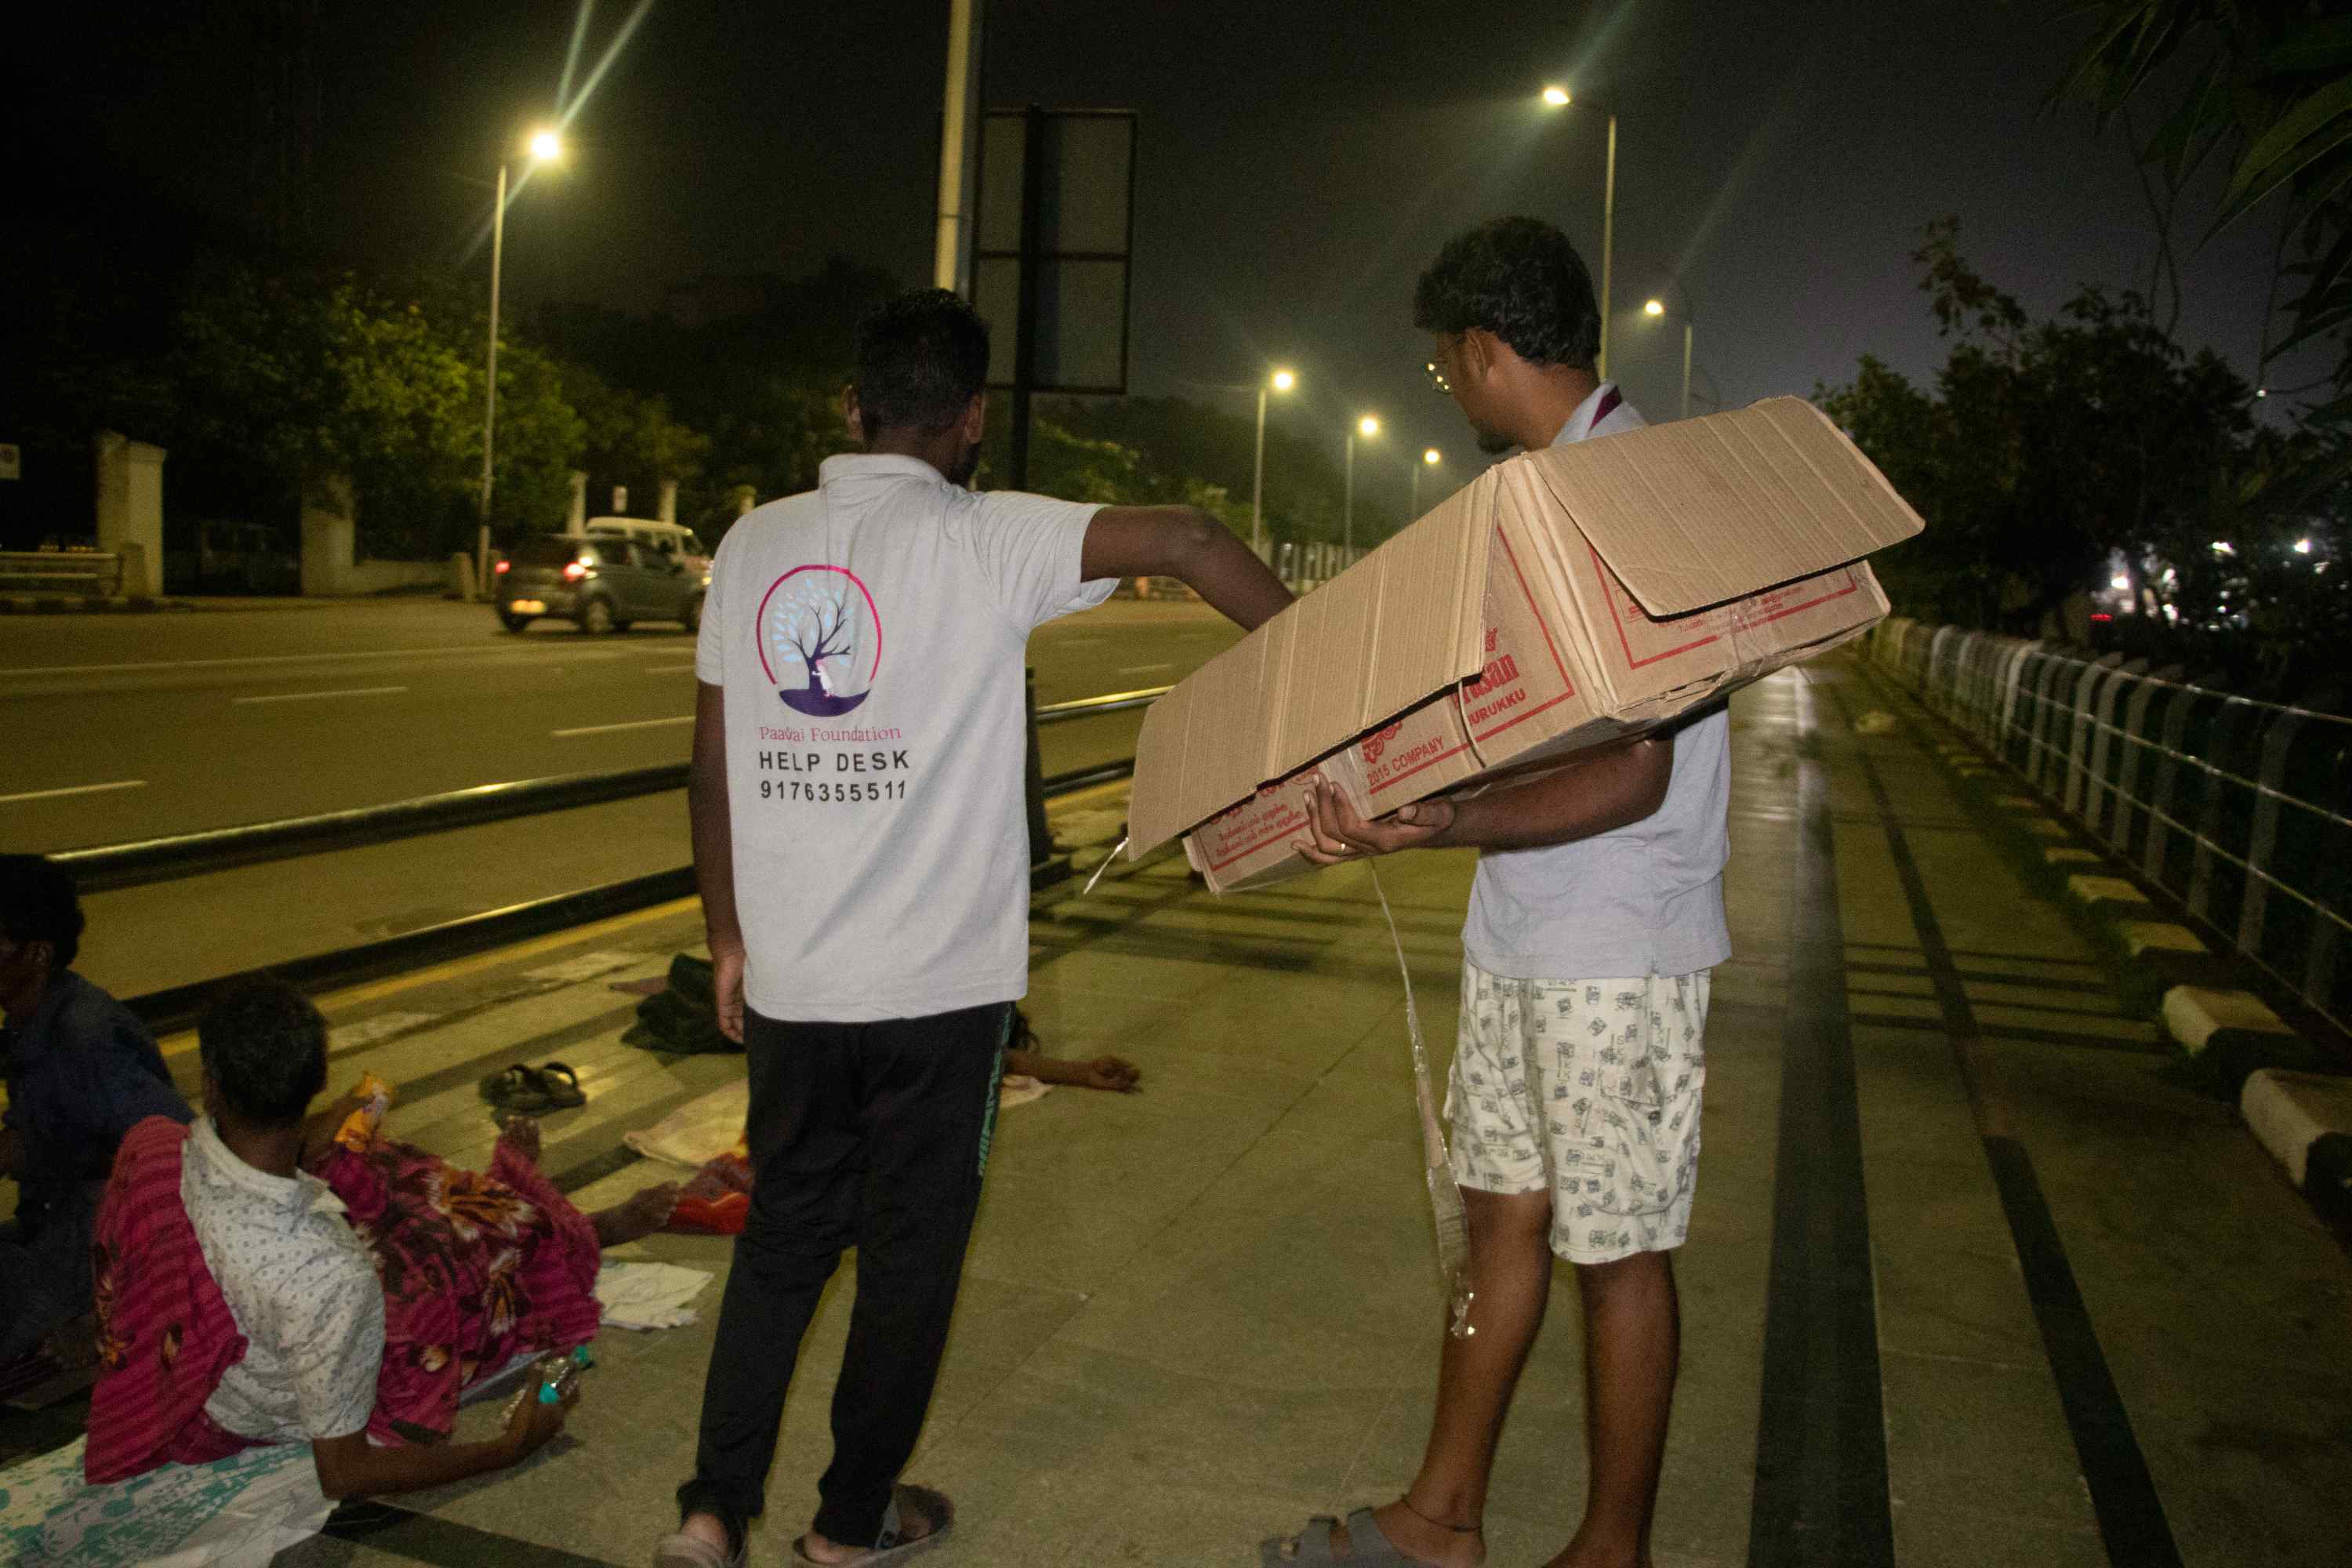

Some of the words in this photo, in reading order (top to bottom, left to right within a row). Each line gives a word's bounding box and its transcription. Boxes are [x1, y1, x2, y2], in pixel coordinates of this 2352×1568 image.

[811, 725, 902, 742] Foundation
[759, 750, 821, 772] HELP
[837, 750, 909, 773] DESK
[1367, 764, 1390, 786] 2015
[1392, 735, 1443, 771] COMPANY
[760, 780, 906, 802] 9176355511
